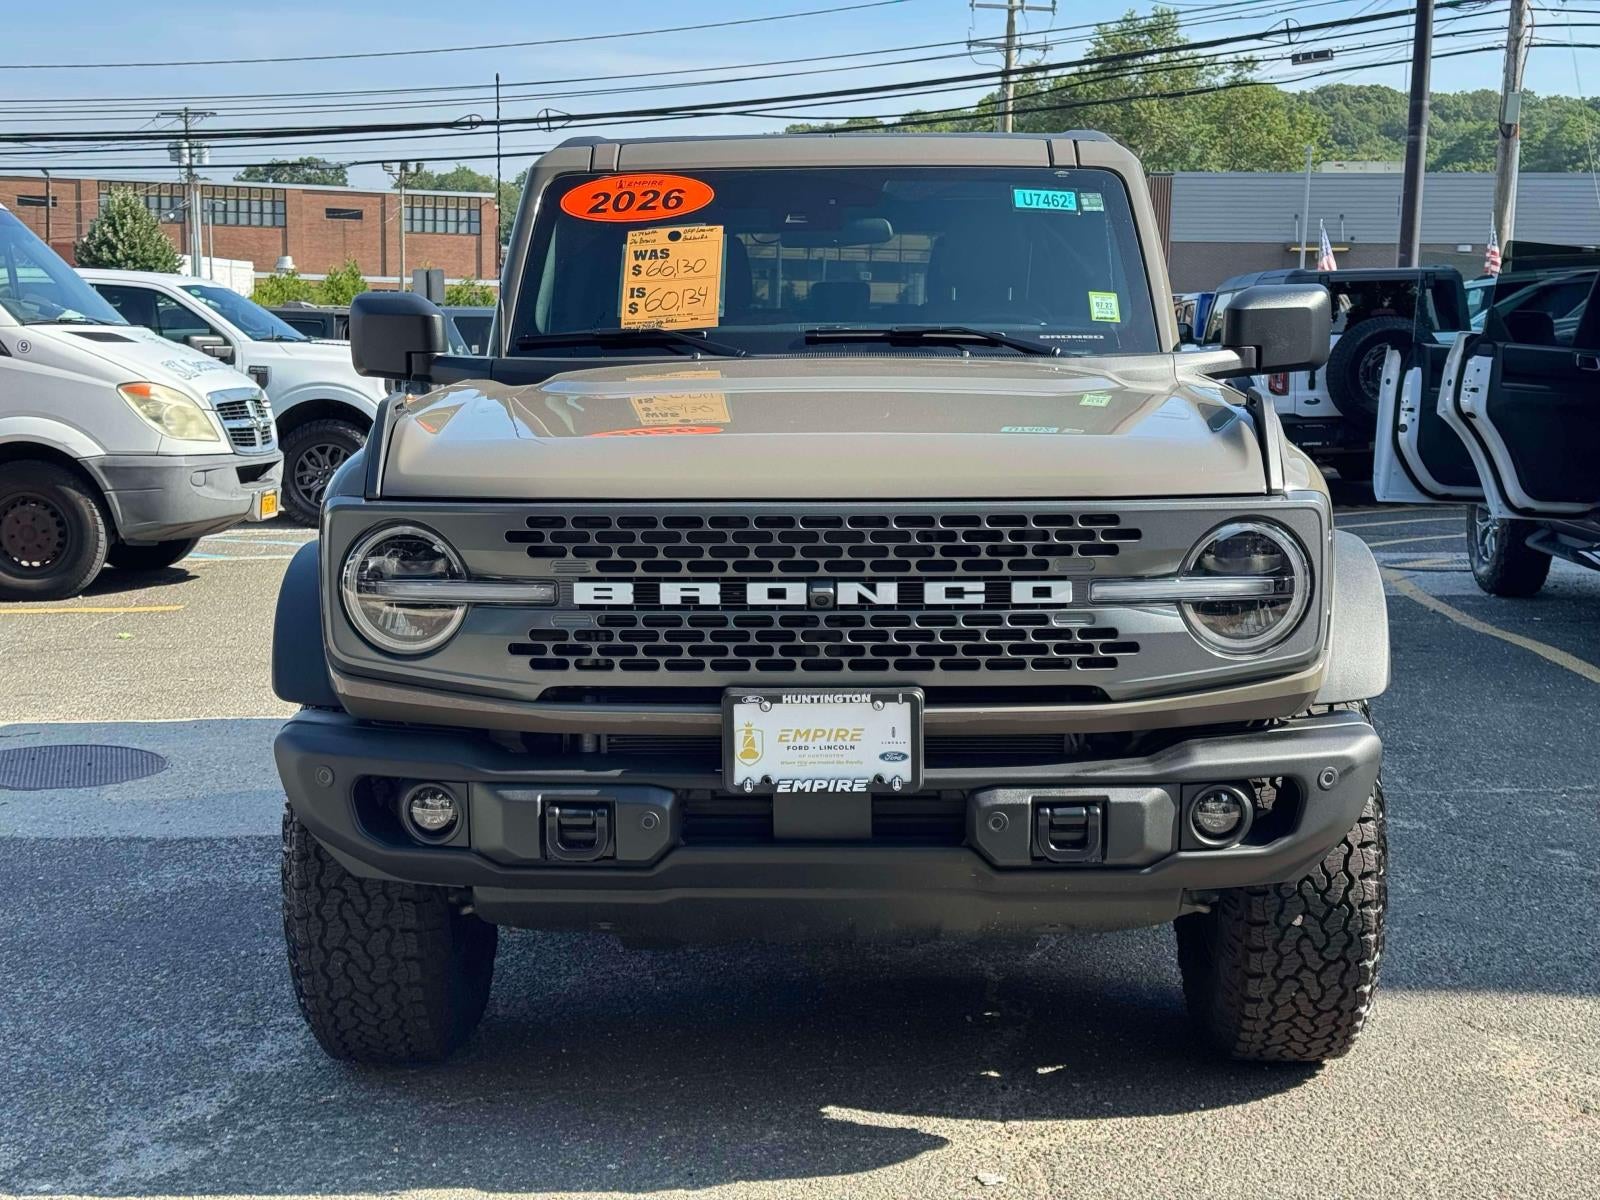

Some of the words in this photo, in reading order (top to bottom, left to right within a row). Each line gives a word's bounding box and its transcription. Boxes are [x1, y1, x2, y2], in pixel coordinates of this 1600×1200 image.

[587, 188, 687, 215] 2026
[1022, 192, 1069, 208] U7462
[633, 248, 670, 261] WAS
[631, 263, 642, 276] $
[645, 258, 707, 278] 66,130
[628, 302, 639, 315] $
[644, 286, 709, 313] 60,134
[629, 287, 646, 299] IS
[573, 581, 1073, 606] BRONCO
[782, 694, 871, 704] HUNTINGTON
[777, 727, 866, 743] EMPIRE
[884, 752, 904, 761] Ford
[776, 779, 869, 793] EMPIRE
